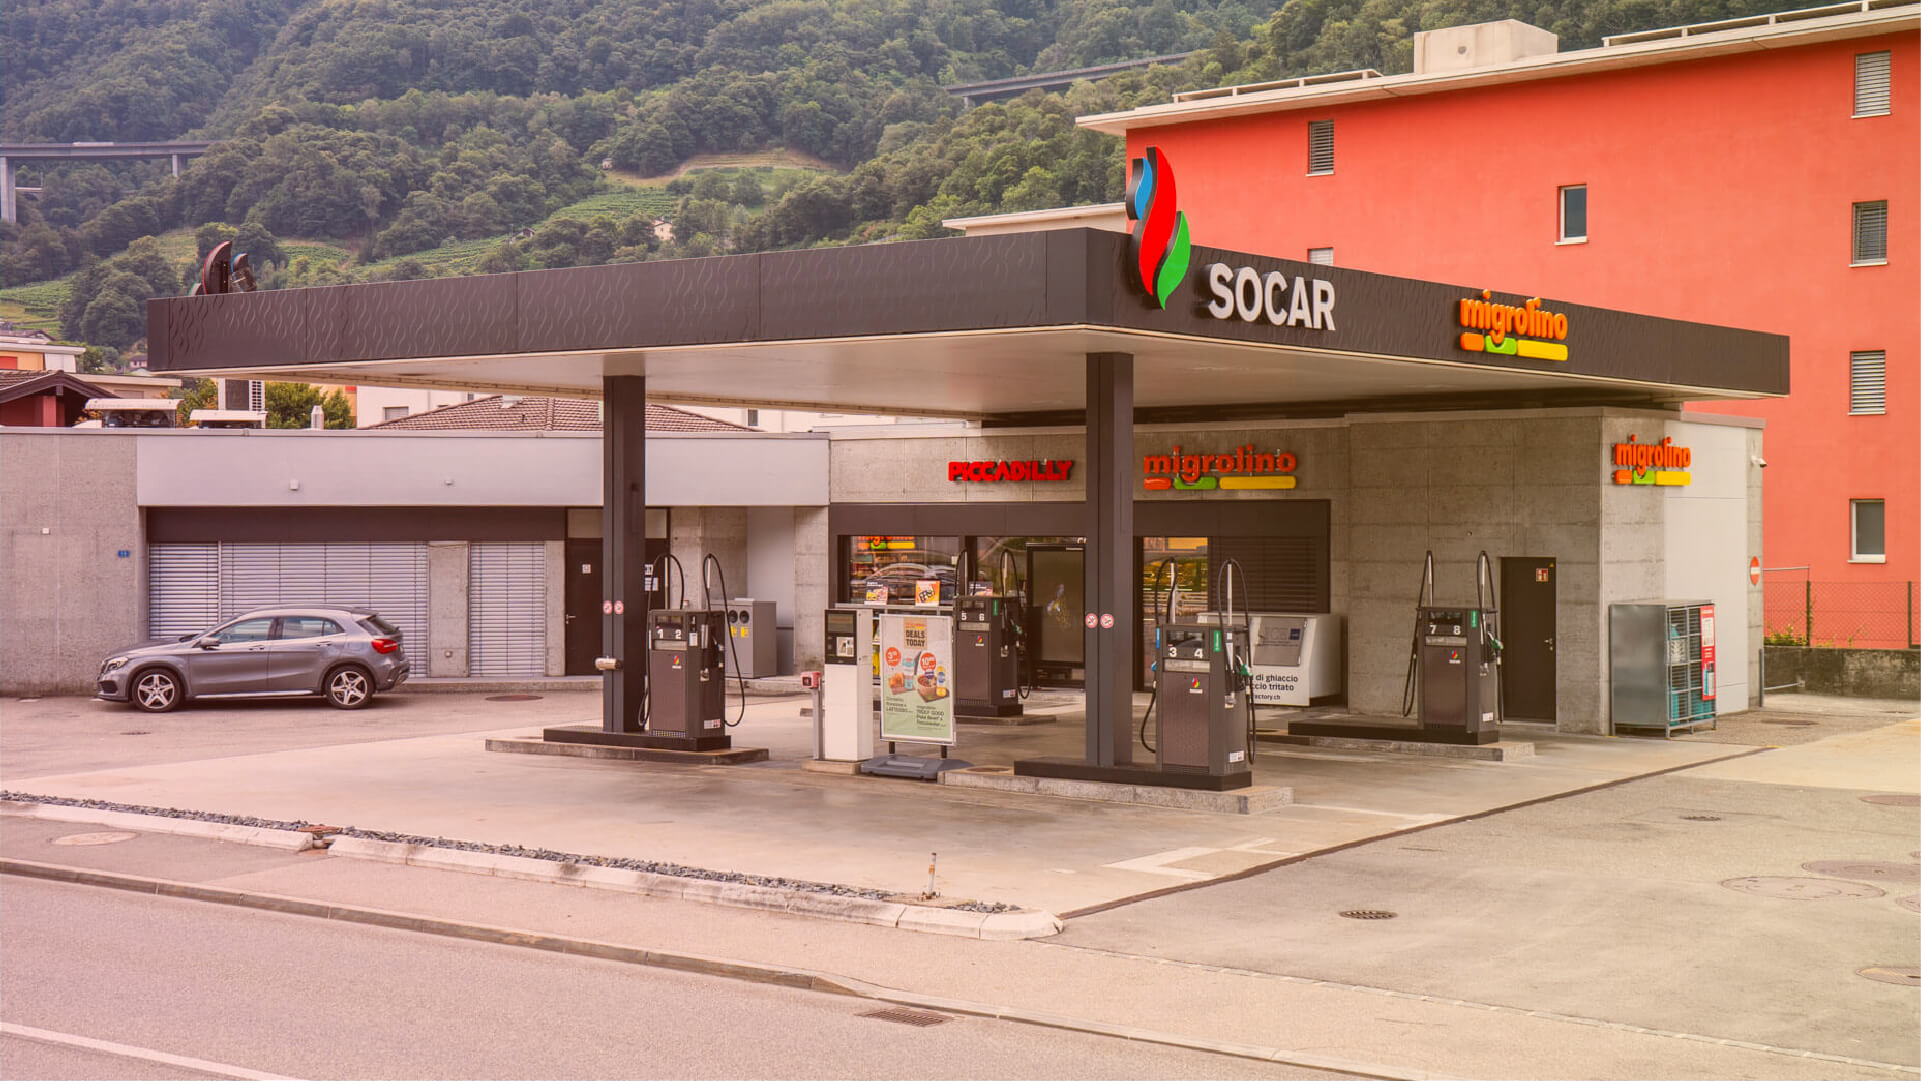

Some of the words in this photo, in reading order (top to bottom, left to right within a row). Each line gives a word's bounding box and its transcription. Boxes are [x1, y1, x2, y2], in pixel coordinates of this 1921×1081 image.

[1208, 262, 1336, 331] SOCAR
[1460, 288, 1568, 344] migrolino
[1614, 434, 1691, 476] migrolino
[1144, 444, 1297, 481] migrolino
[961, 612, 967, 621] 5
[979, 613, 985, 621] 6
[657, 629, 664, 639] 1
[675, 629, 682, 640] 2
[905, 630, 925, 639] DEALS
[1429, 624, 1437, 635] 7
[1453, 625, 1461, 635] 8
[905, 639, 925, 647] TODAY
[1169, 647, 1177, 657] 3
[1194, 648, 1203, 659] 4
[1255, 673, 1264, 681] di
[1265, 673, 1299, 683] ghiaccio
[1269, 683, 1294, 691] tritato
